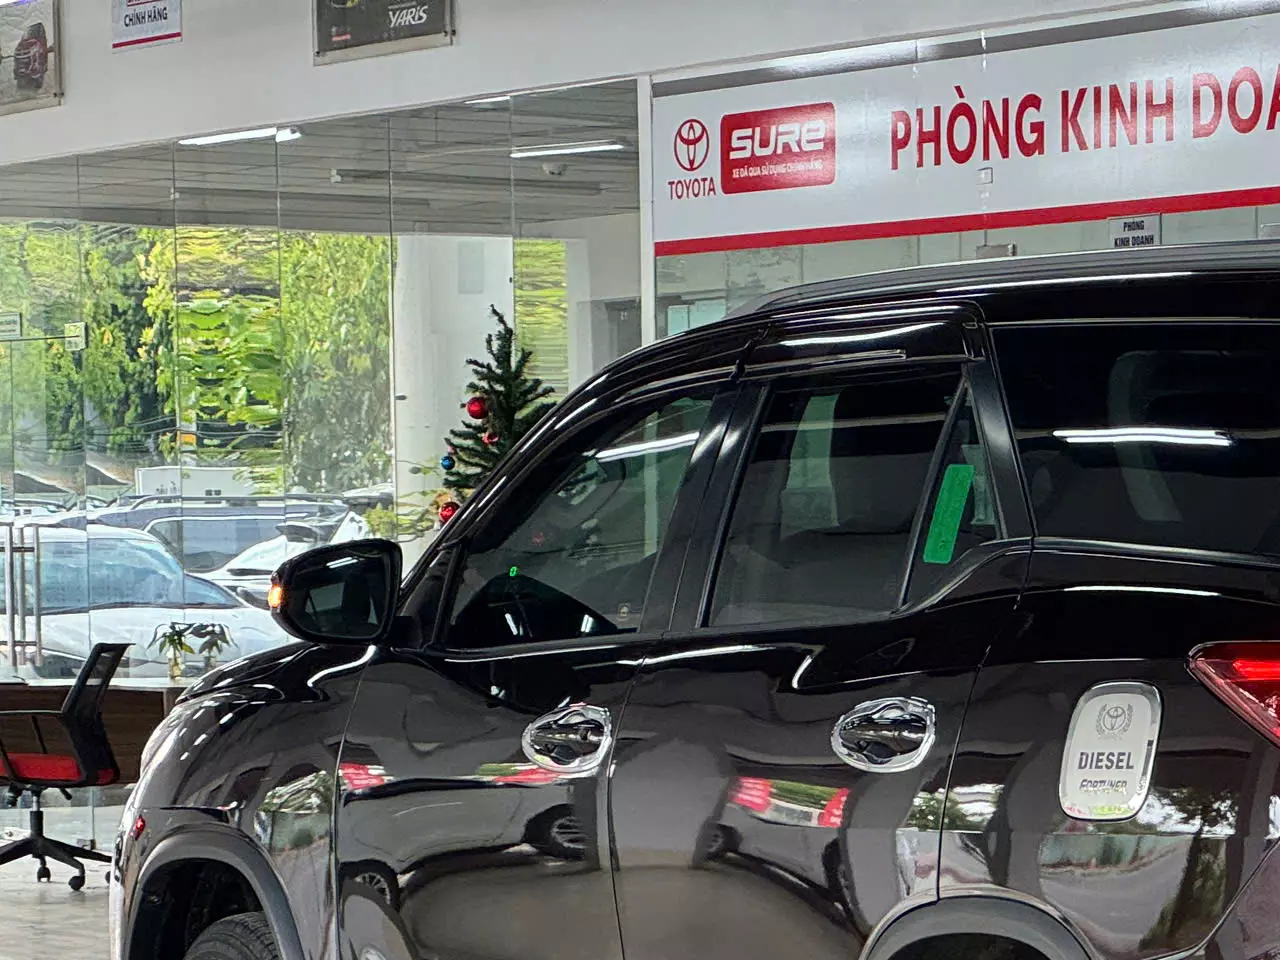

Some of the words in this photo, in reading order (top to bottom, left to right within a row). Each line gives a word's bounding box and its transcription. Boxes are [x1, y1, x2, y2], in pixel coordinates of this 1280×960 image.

[890, 86, 1048, 171] PHÒNG
[1060, 84, 1175, 153] KINH
[668, 176, 716, 200] TOYOTA
[1078, 751, 1134, 770] DIESEL
